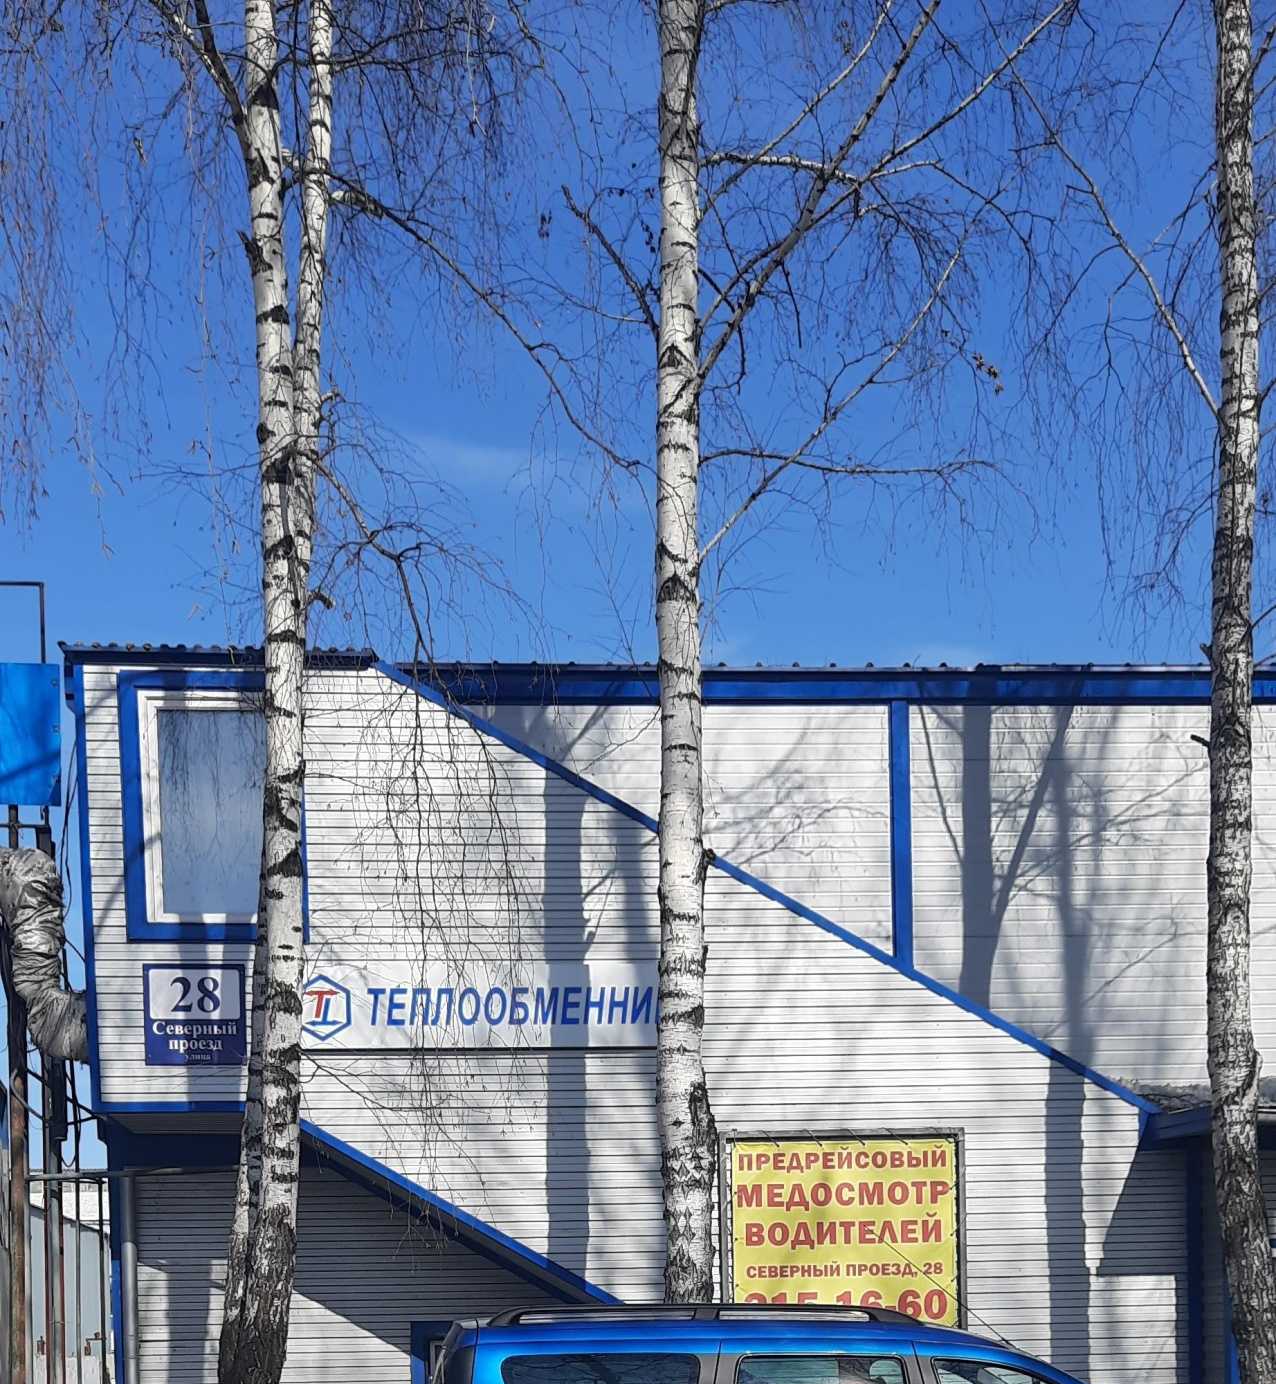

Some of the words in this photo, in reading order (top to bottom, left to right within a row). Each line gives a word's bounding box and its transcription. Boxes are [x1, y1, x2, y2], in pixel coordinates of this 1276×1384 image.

[170, 977, 220, 1013] 28
[152, 1021, 237, 1038] Северный
[168, 1039, 223, 1053] проезд
[738, 1144, 947, 1173] ПРЕДРЕЙСОВЫЙ
[737, 1181, 949, 1212] МЕДОСМОТР
[745, 1212, 942, 1250] ВОДИТЕЛЕЙ
[746, 1261, 841, 1278] СЕВЕРНЫЙ
[846, 1262, 918, 1278] ПРОЕЗД,
[923, 1262, 943, 1275] 28
